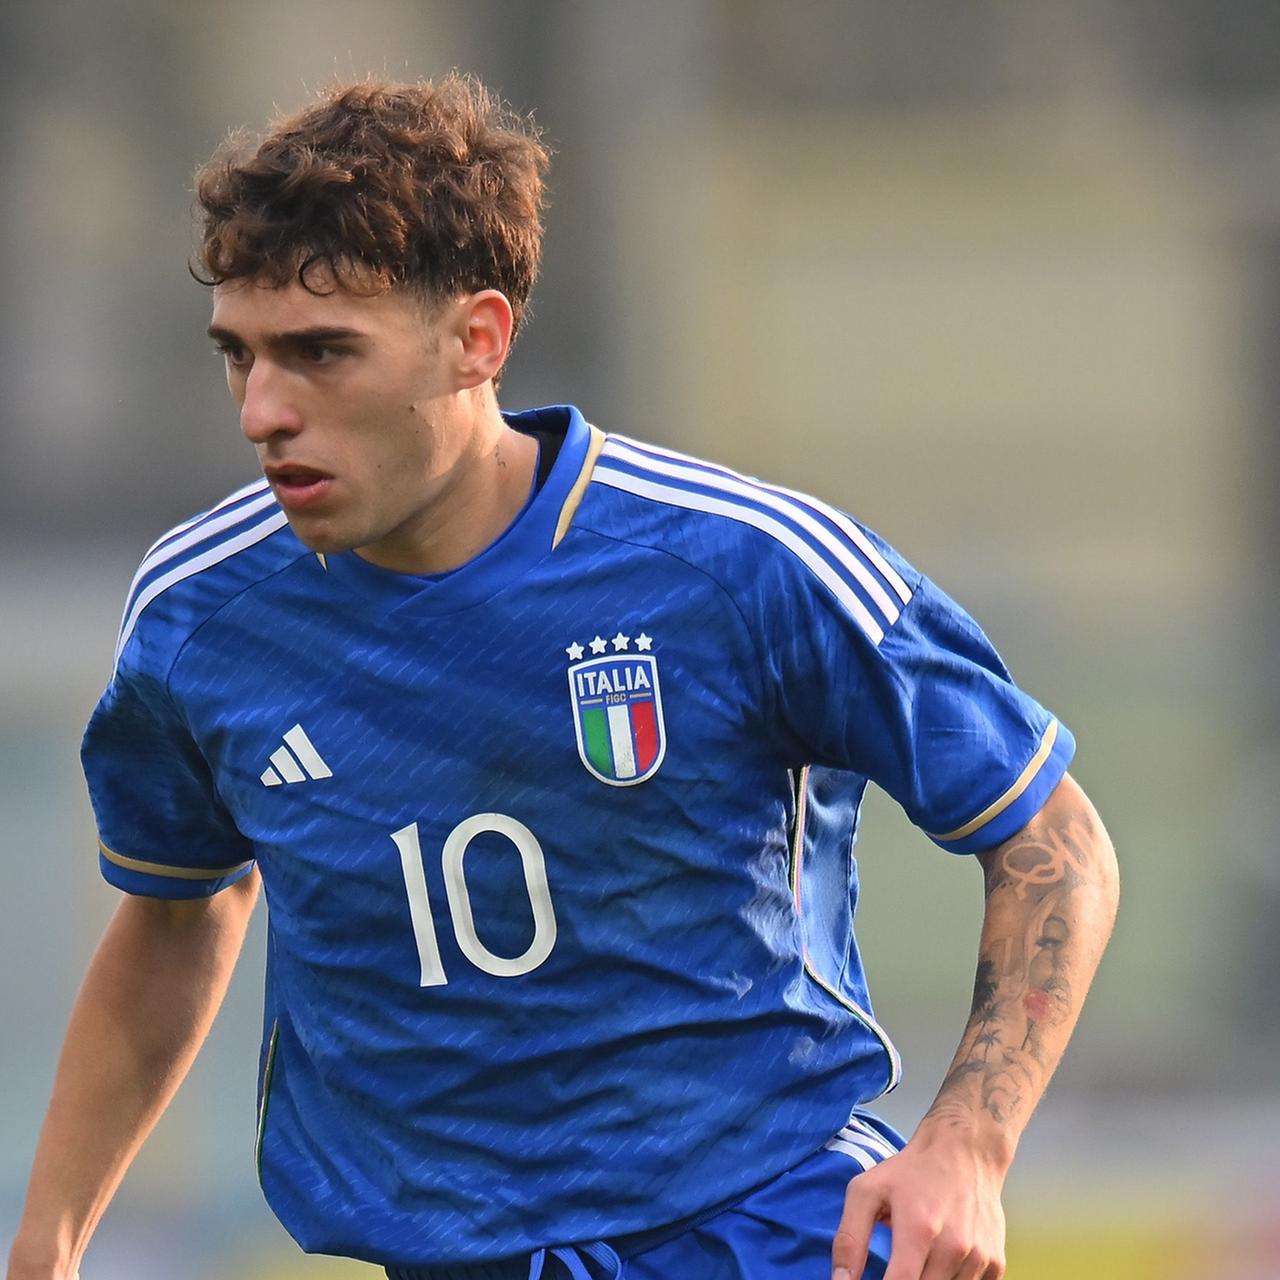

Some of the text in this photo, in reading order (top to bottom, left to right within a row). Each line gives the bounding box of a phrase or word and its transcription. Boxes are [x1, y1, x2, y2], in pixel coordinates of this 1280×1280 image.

[576, 665, 651, 697] ITALIA
[605, 693, 627, 705] FIGC
[390, 813, 558, 987] 10
